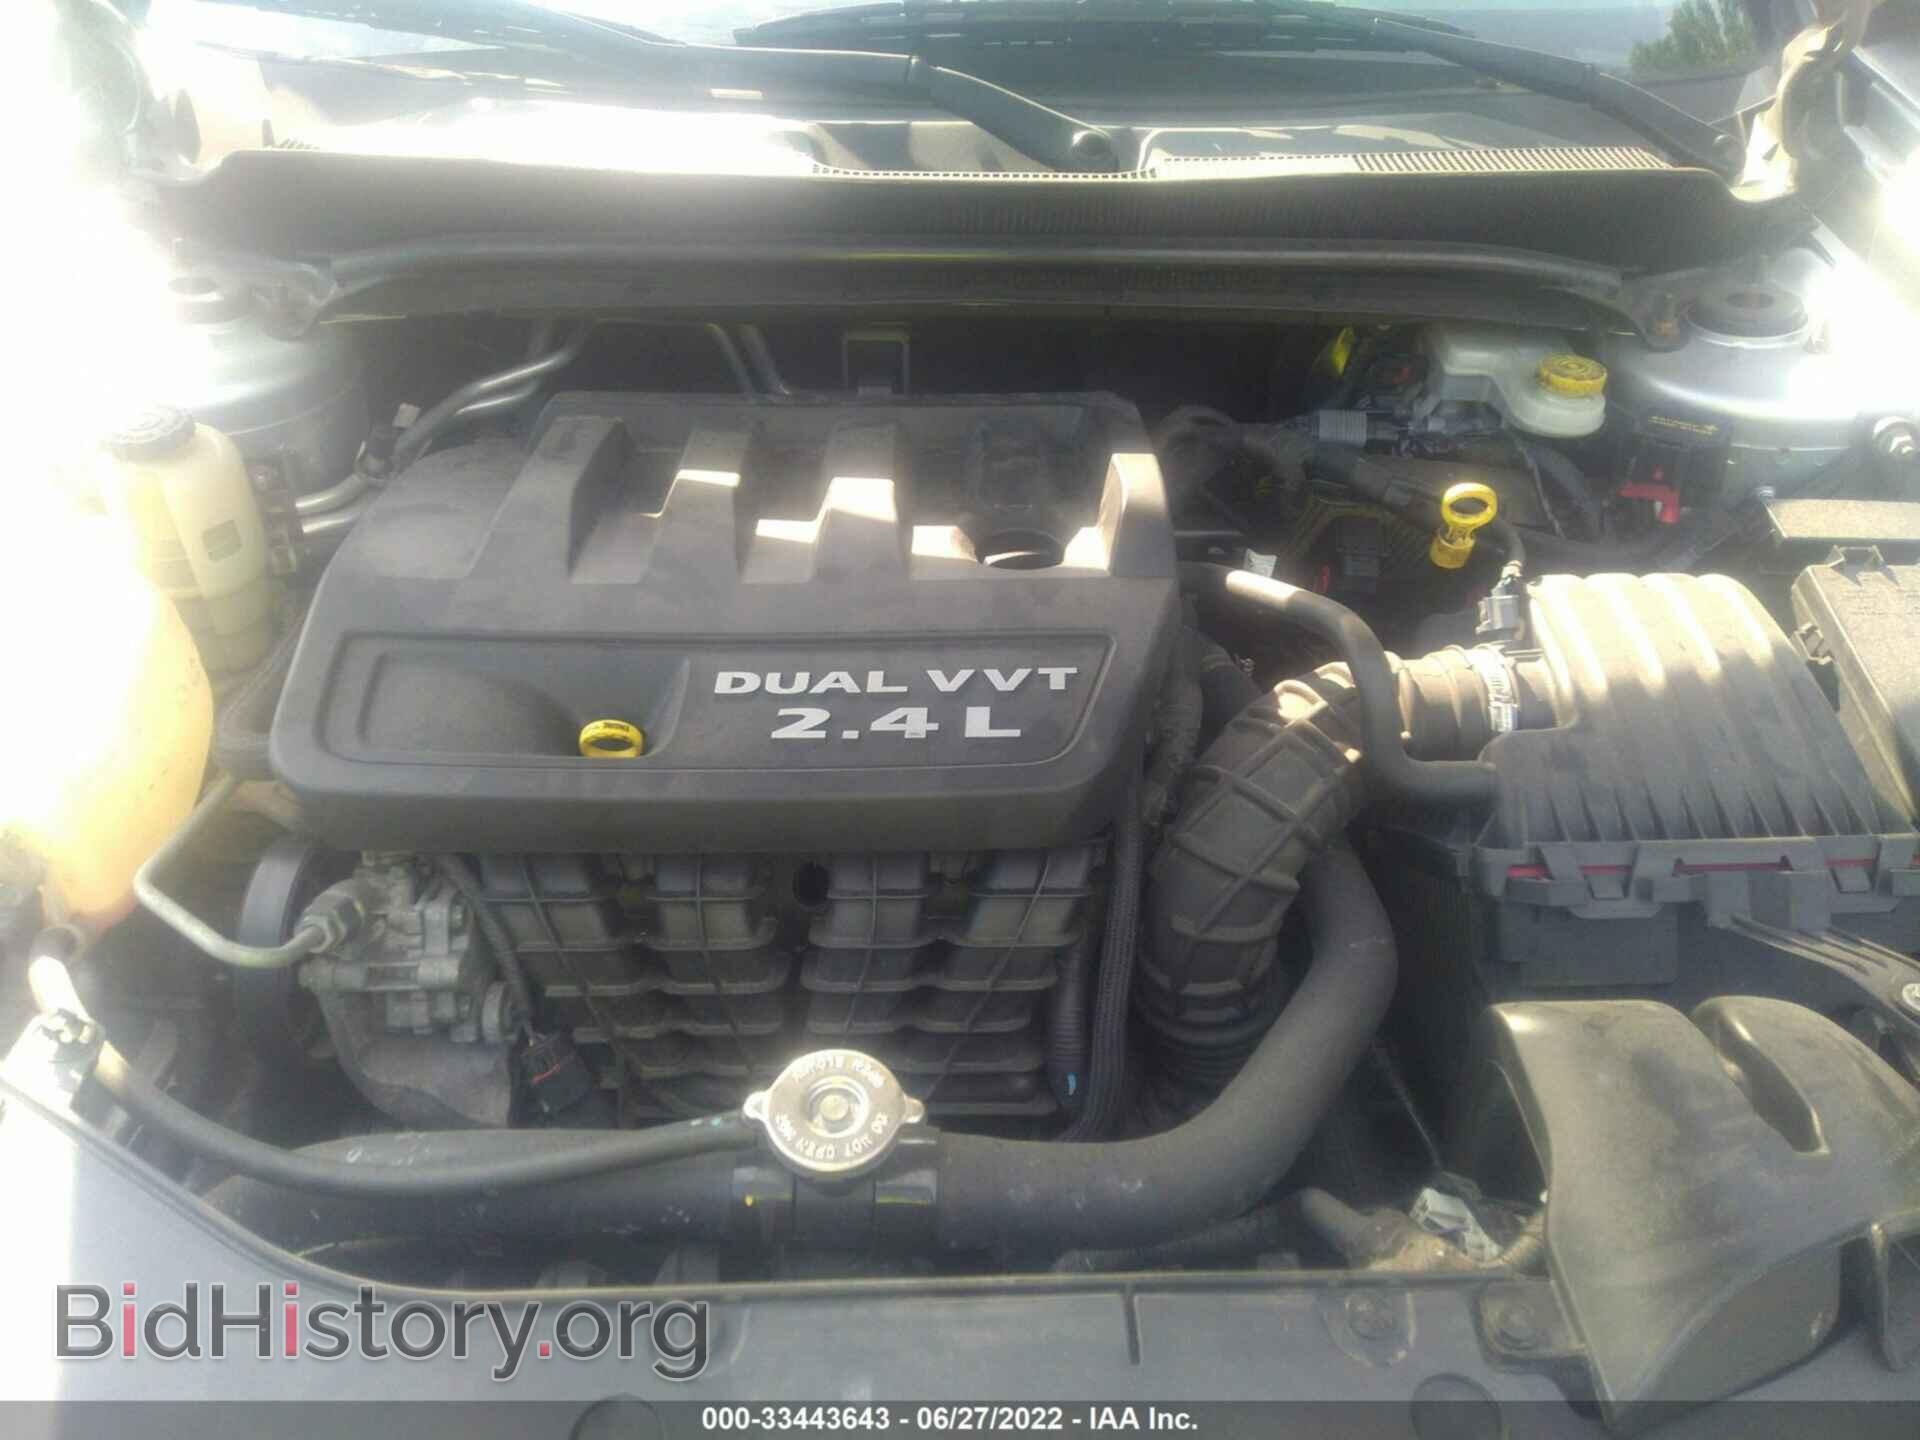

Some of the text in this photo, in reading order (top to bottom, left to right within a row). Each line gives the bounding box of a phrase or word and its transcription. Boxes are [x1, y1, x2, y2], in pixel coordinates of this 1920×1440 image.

[713, 665, 1078, 695] DUAL VVT
[769, 705, 1022, 740] 2.4 L
